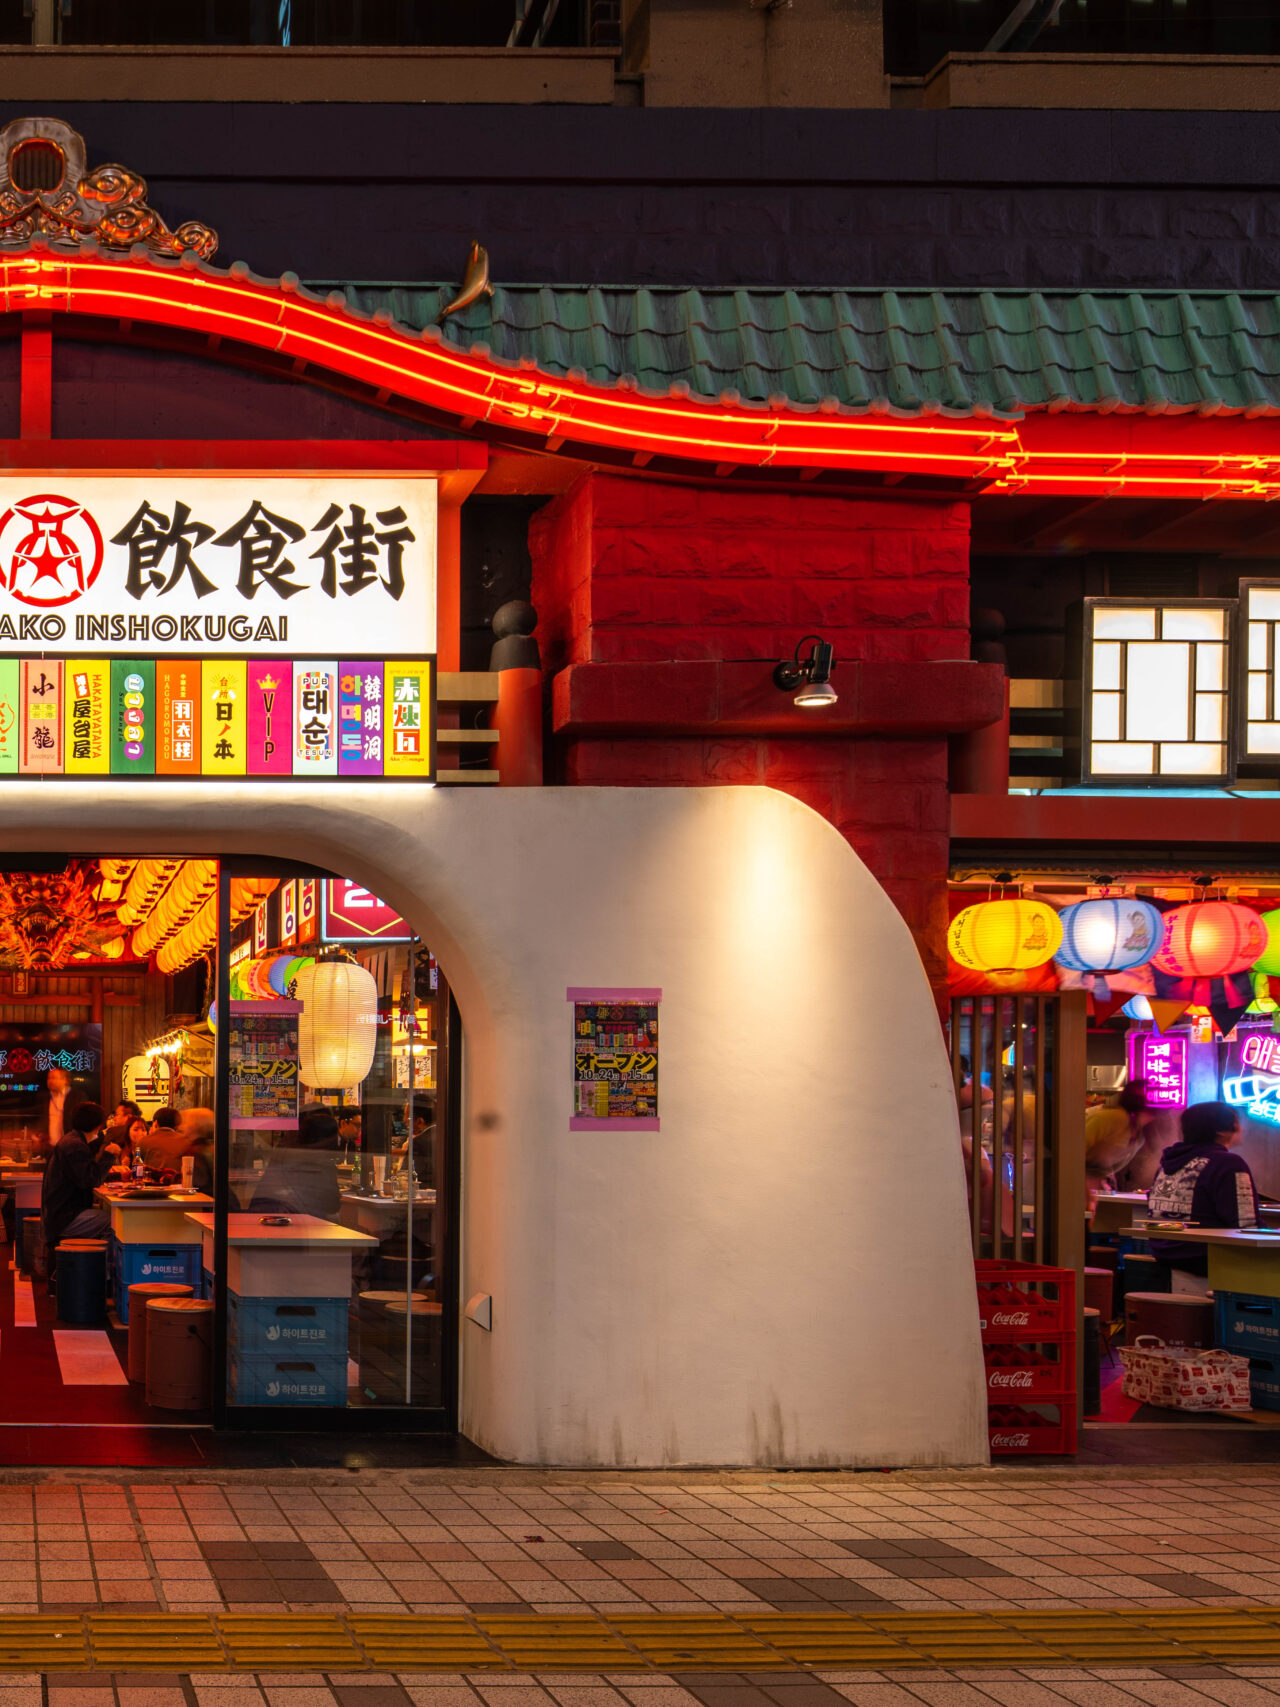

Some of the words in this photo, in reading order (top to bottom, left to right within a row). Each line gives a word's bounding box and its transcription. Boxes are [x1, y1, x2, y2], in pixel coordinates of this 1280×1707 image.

[109, 500, 416, 601] 飲食街
[75, 614, 288, 641] INSHOKUGAI
[263, 692, 275, 762] VIP
[302, 690, 328, 745] 태순
[213, 702, 235, 760] 日ノ本
[576, 1051, 658, 1075] オープン
[153, 1266, 184, 1274] 하이트진로
[991, 1312, 1030, 1326] Coca-Cola
[282, 1328, 326, 1339] 하이트진로
[282, 1384, 326, 1394] 하이트진로
[989, 1371, 1034, 1388] Coca-Cola
[991, 1434, 1030, 1447] Coca-Cola
